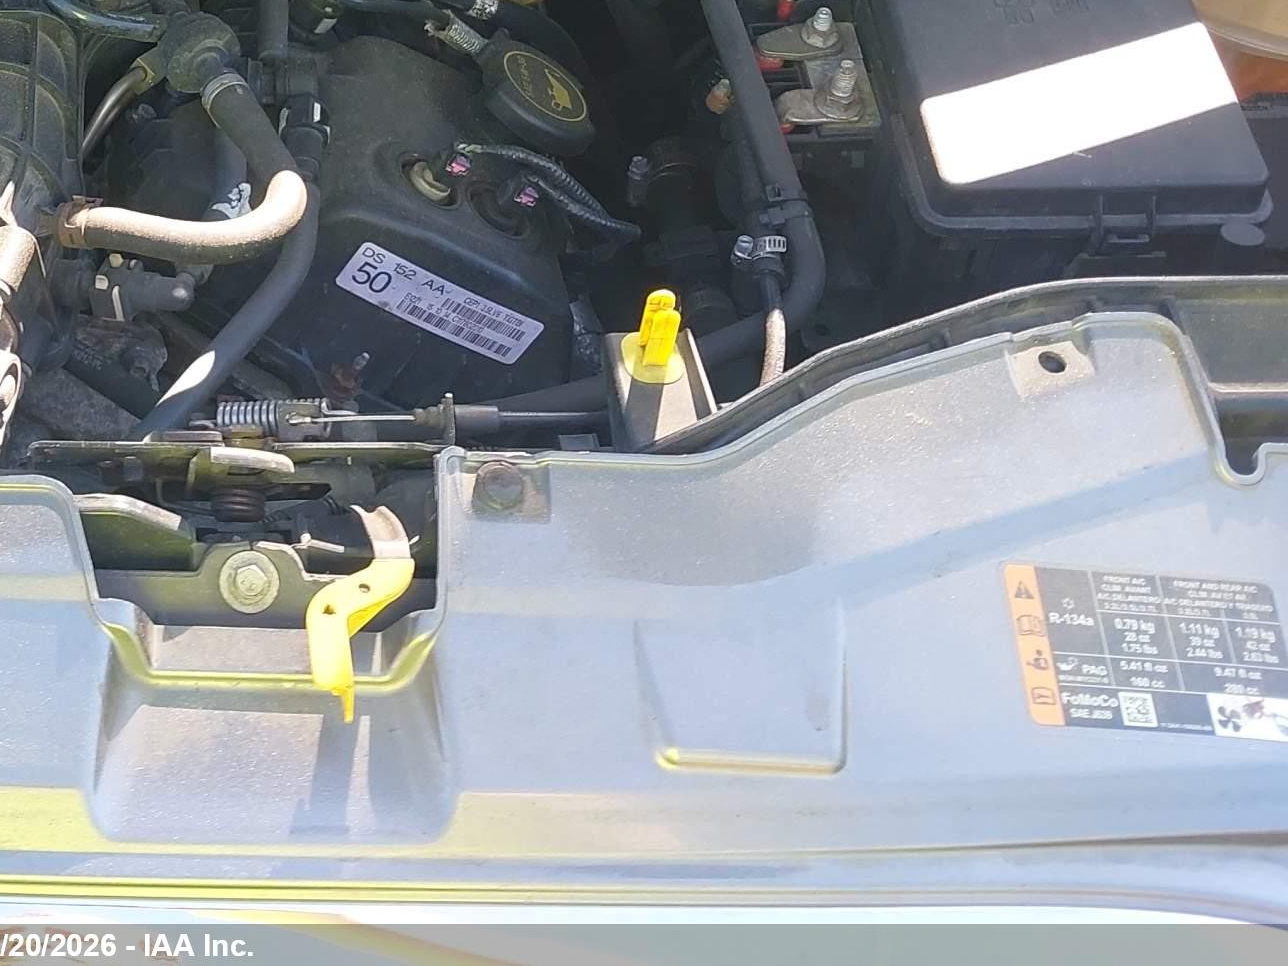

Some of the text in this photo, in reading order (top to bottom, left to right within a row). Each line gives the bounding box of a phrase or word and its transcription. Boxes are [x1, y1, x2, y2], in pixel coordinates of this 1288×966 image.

[352, 261, 392, 293] 50
[362, 247, 386, 264] DS
[392, 262, 416, 281] 152
[421, 279, 445, 296] AA
[1048, 612, 1094, 626] R-134a
[1139, 620, 1155, 634] kg
[1179, 622, 1220, 639] 1.11 kg
[1259, 629, 1275, 643] kg
[1061, 692, 1119, 707] FoMoCo
